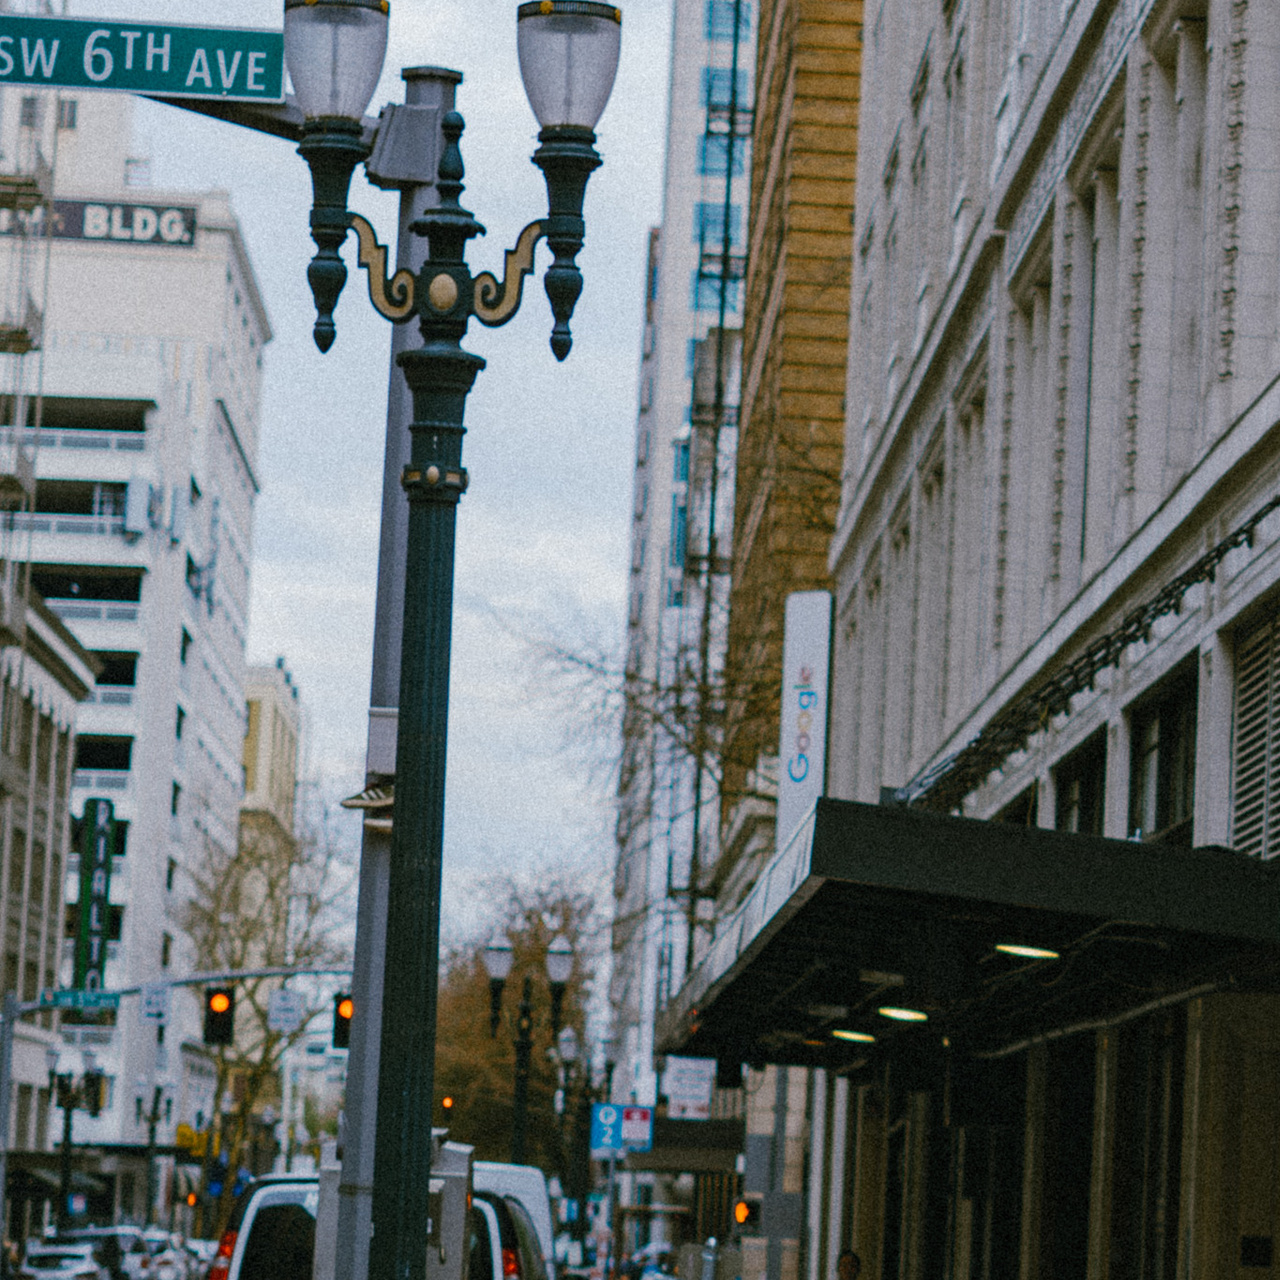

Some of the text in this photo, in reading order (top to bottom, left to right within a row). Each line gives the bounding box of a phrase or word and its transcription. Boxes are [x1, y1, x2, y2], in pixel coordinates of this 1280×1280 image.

[0, 29, 267, 91] SW 6TH AVE
[83, 204, 191, 242] BLDG.
[788, 666, 818, 783] Google
[601, 1126, 613, 1145] 2
